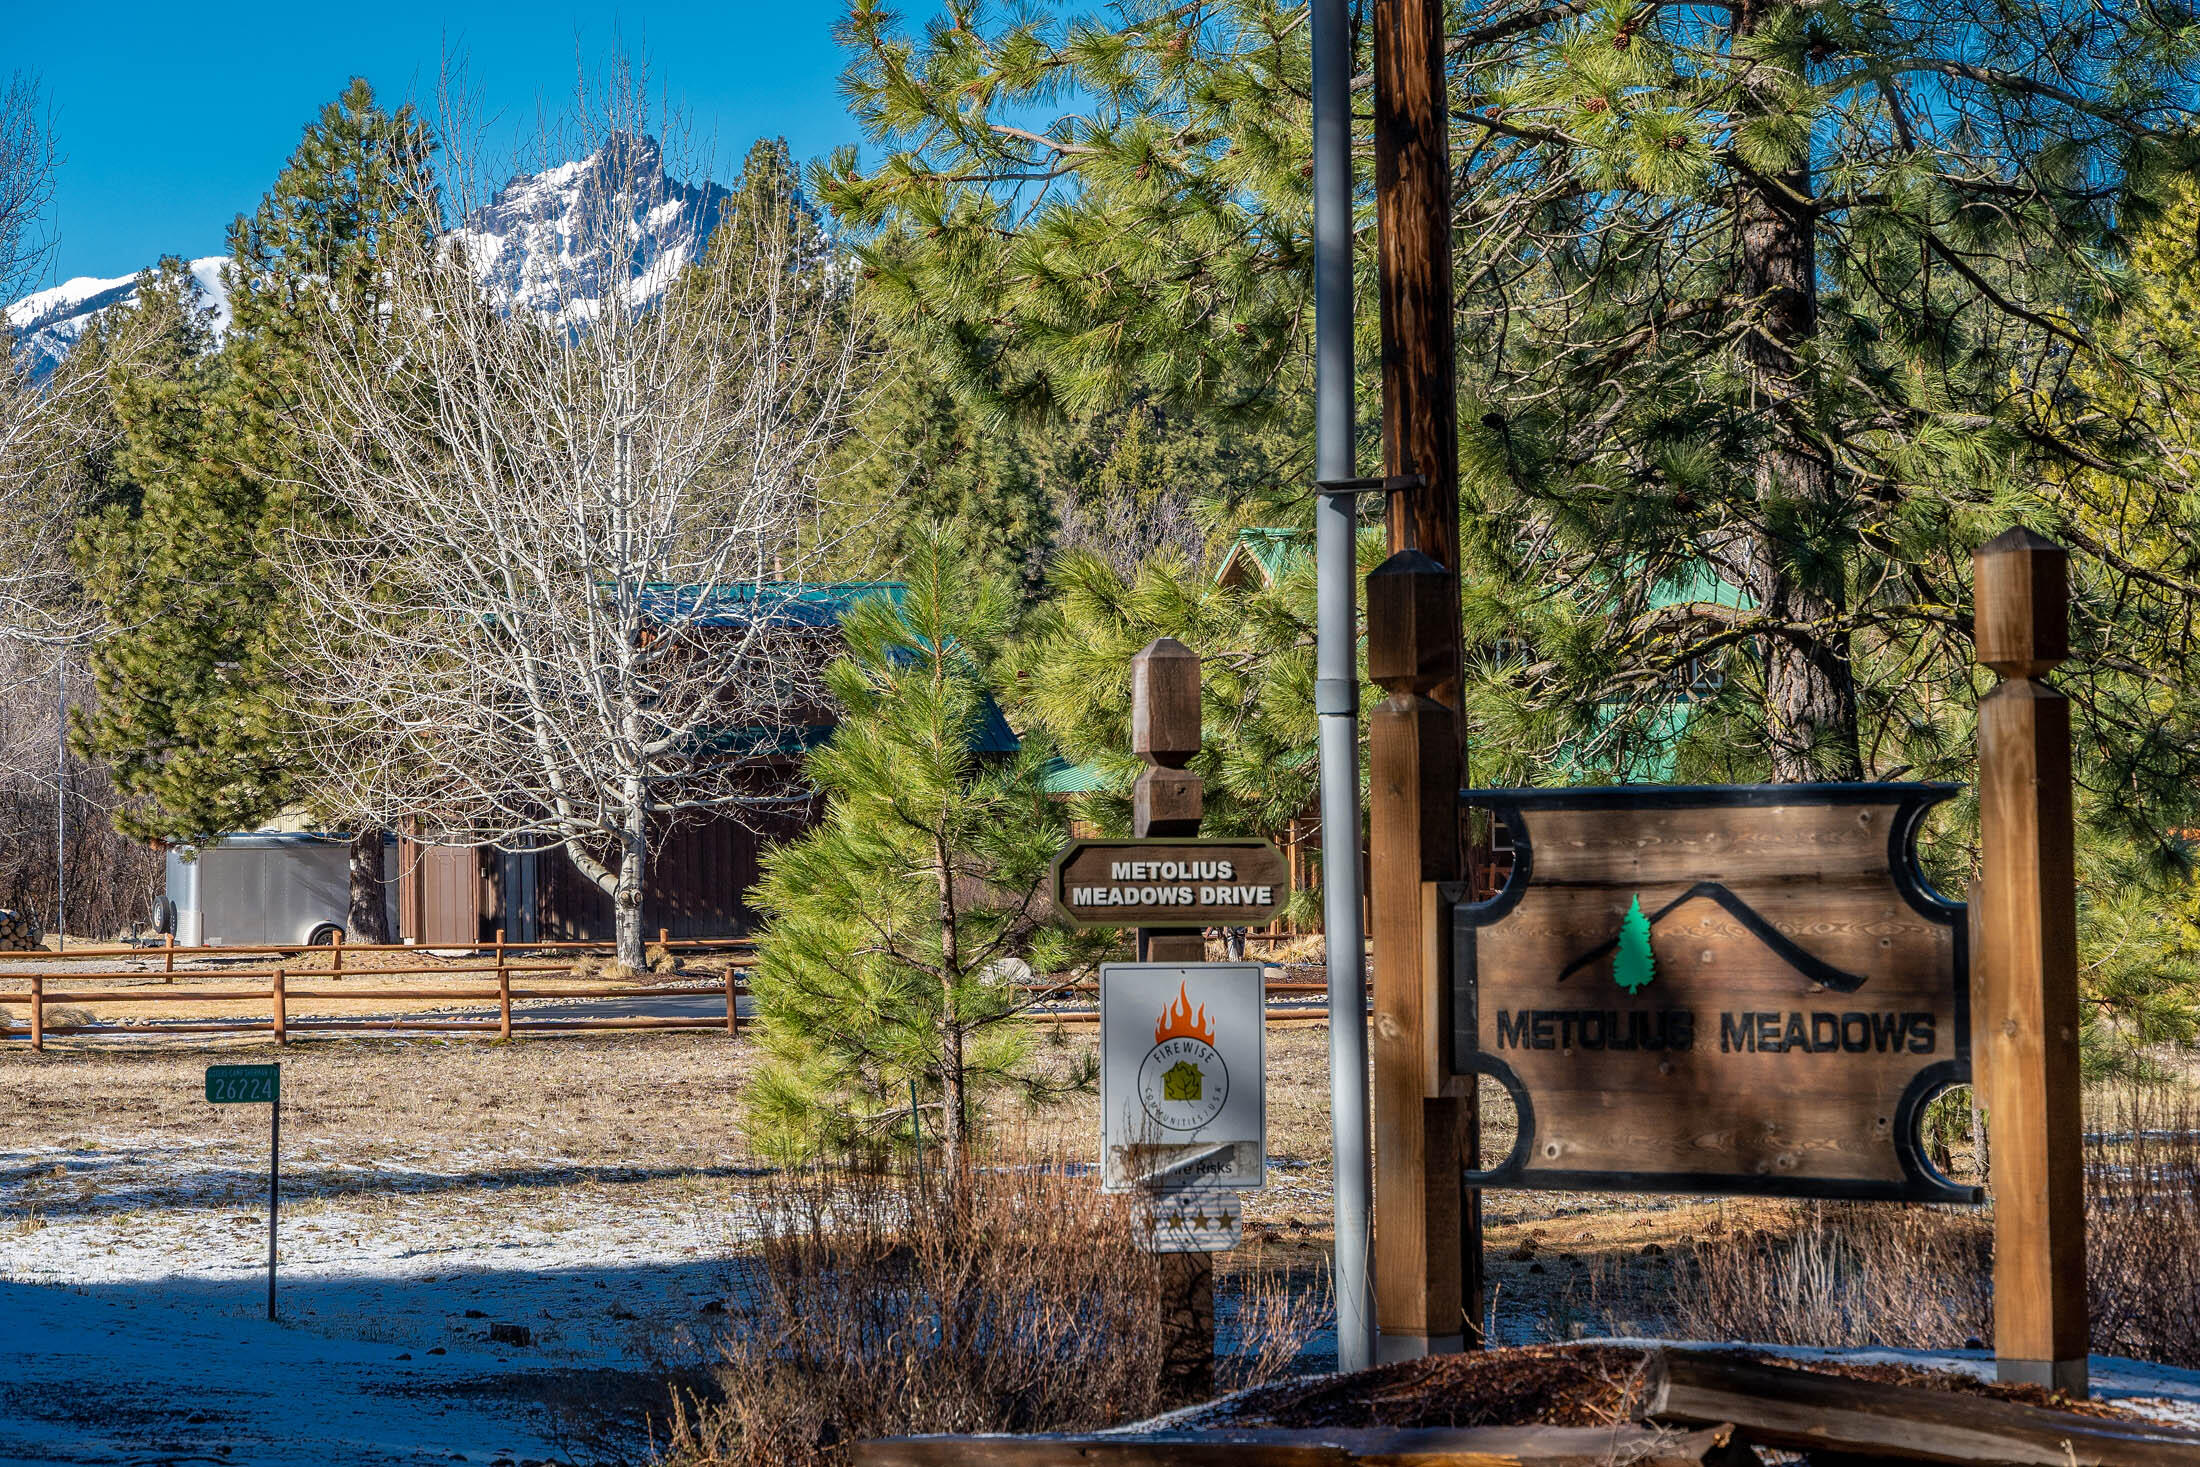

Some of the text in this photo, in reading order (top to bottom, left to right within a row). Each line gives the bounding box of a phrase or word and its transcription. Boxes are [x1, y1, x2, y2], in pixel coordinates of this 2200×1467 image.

[1111, 861, 1234, 880] METOLIUS
[1072, 886, 1272, 906] MEADOWS DRIVE
[1496, 1009, 1937, 1055] METOLIUS MEADOWS
[1152, 1041, 1214, 1064] FIREWISE
[1196, 1161, 1232, 1175] Risks
